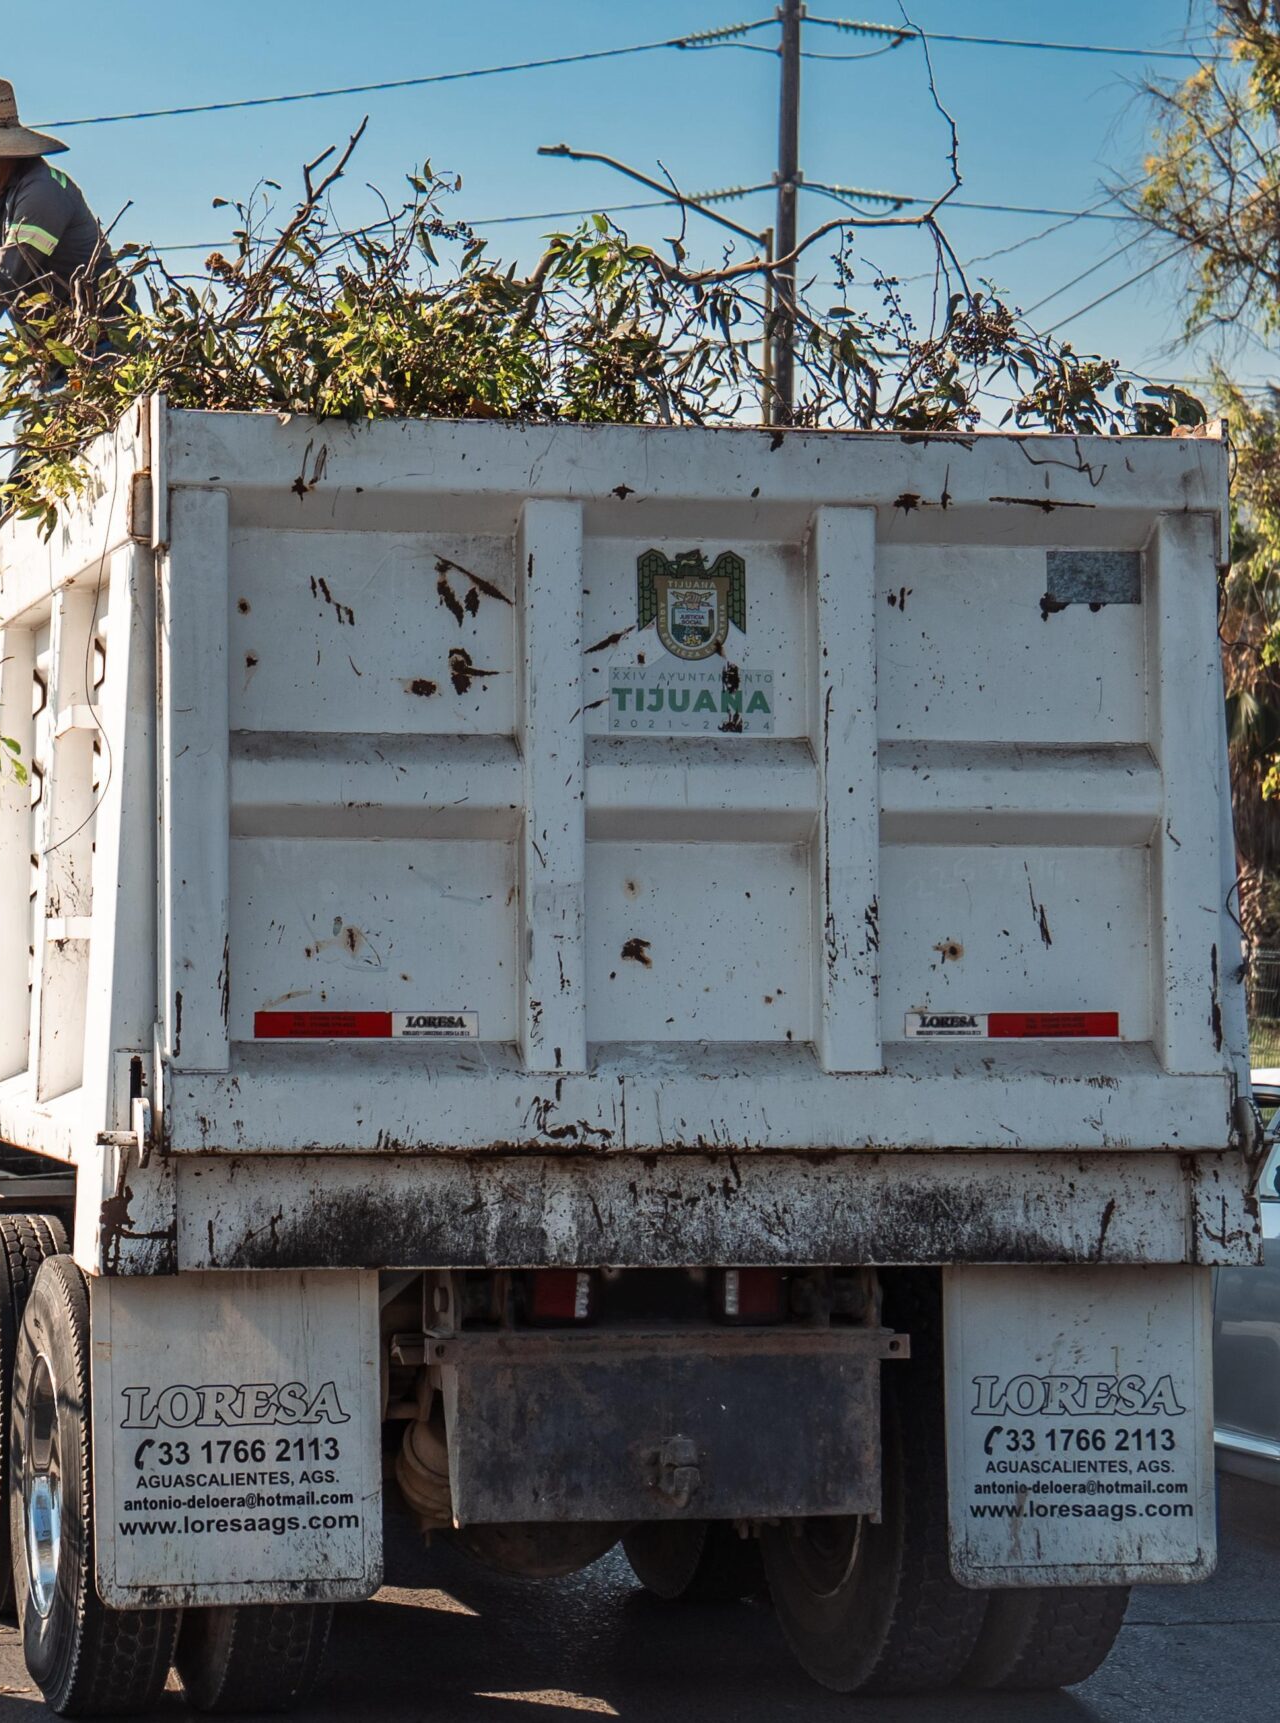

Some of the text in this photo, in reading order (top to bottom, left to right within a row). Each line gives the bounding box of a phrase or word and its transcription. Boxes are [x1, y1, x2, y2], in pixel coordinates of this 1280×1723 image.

[667, 580, 717, 589] TIJUANA
[612, 671, 773, 683] XXIV AYUNTANTO
[611, 687, 772, 714] TIJUANA
[703, 720, 770, 730] 224
[405, 1015, 467, 1029] LORESA
[919, 1015, 979, 1028] LORESA
[971, 1374, 1186, 1416] LORESA
[120, 1381, 351, 1429] LORESA
[1006, 1428, 1176, 1452] 33 1766 2113
[158, 1437, 340, 1466] 33 1766 2113
[985, 1460, 1175, 1475] AGUASCALIENTES, AGS.
[136, 1470, 340, 1489] AGUASCALIENTES, AGS.
[974, 1480, 1188, 1496] antonio-deloera@hotmail.com
[123, 1492, 354, 1511] antonio-deloera@hotmail.com
[970, 1500, 1194, 1522] www.loresaags.com
[119, 1514, 360, 1536] www.loresaags.com
